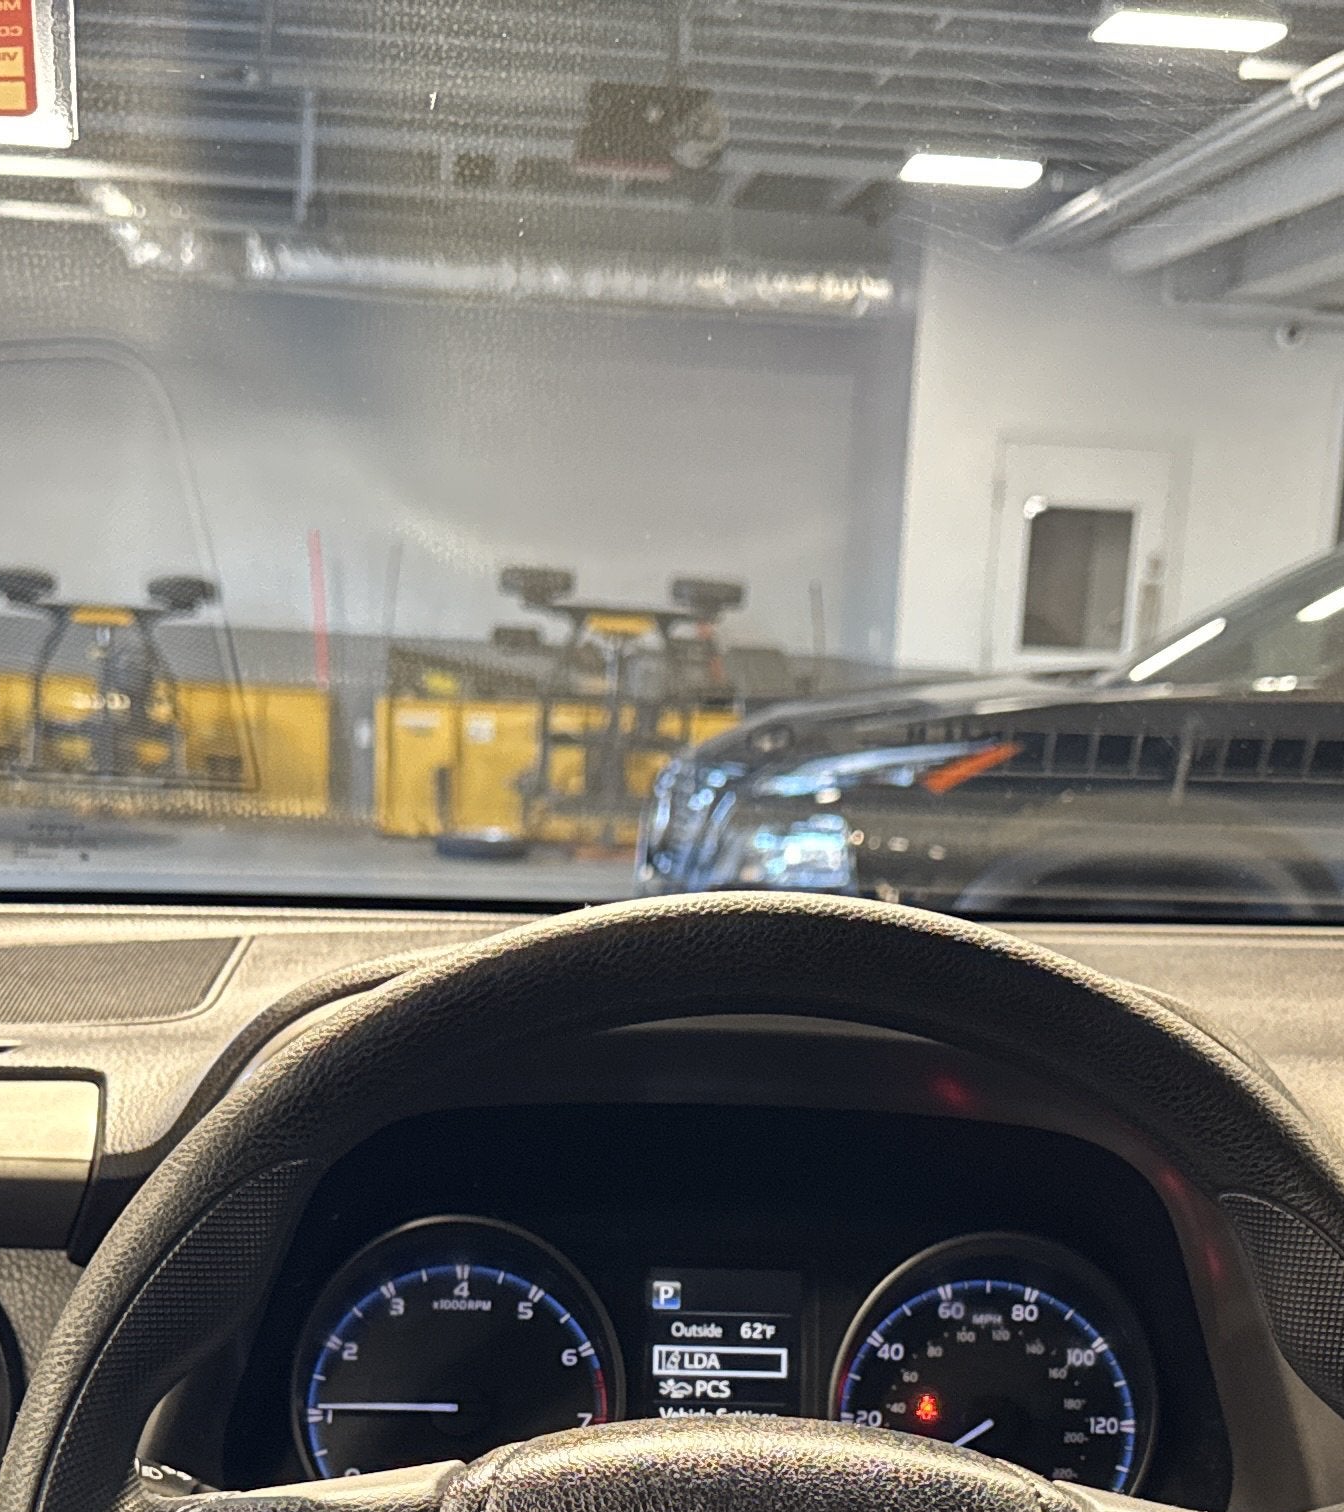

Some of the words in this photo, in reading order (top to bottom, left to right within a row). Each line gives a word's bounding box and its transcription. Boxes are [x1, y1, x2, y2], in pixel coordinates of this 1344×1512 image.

[453, 1281, 470, 1298] 4
[390, 1298, 405, 1315] 3
[517, 1303, 534, 1320] 5
[938, 1302, 965, 1319] 60
[1011, 1304, 1039, 1322] 80
[671, 1321, 723, 1339] Outside
[342, 1343, 358, 1360] 2
[561, 1349, 578, 1366] 6
[877, 1343, 904, 1361] 40
[1066, 1348, 1095, 1367] 100
[683, 1353, 721, 1370] LDA
[696, 1380, 731, 1398] PCS
[856, 1410, 883, 1428] 20
[1089, 1417, 1119, 1434] 120
